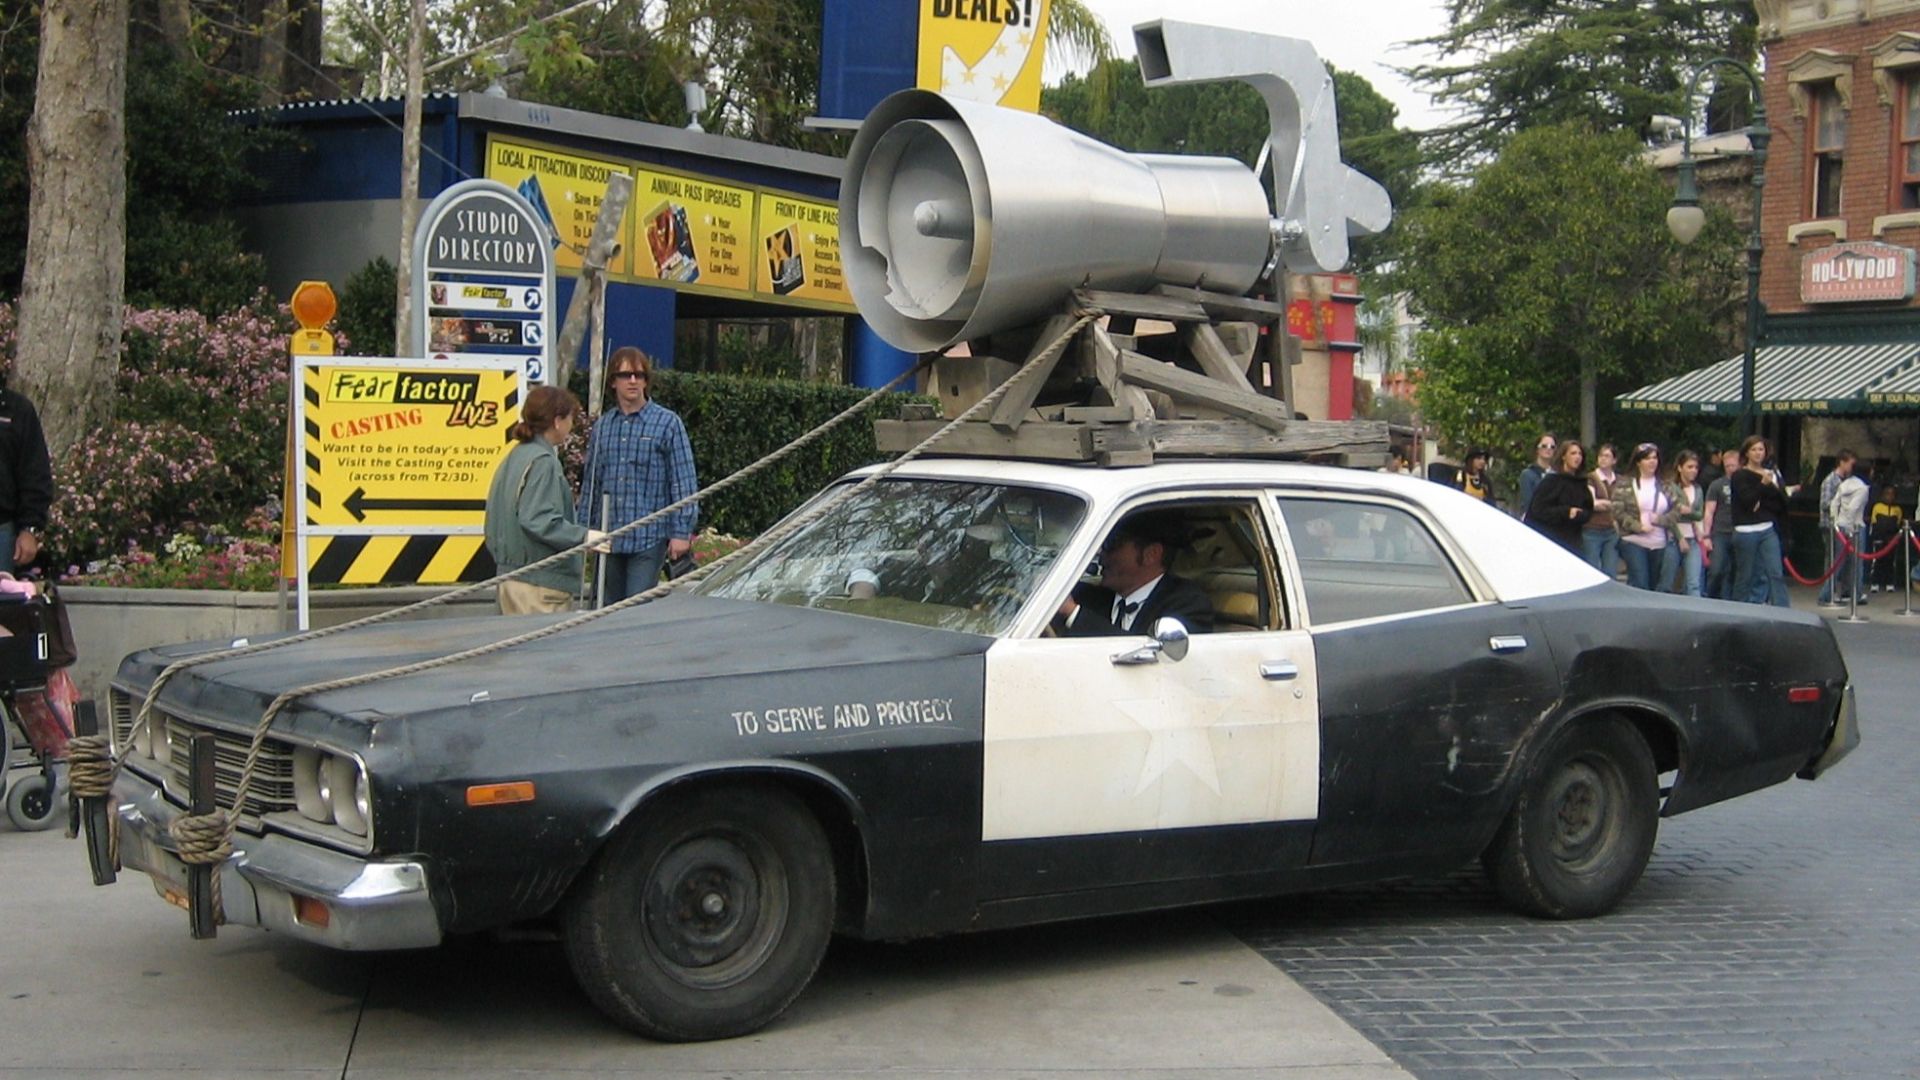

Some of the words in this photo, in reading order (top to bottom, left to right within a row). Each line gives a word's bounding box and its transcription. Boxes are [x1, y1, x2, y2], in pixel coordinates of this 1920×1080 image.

[497, 148, 525, 169] LOCAL
[527, 155, 577, 178] ATTRACTION
[574, 192, 591, 206] Save
[651, 177, 683, 198] ANNUAL
[684, 183, 703, 202] PASS
[704, 187, 742, 209] UPGRADES
[456, 209, 520, 236] STUDIO
[775, 201, 797, 218] FRONT
[797, 205, 806, 220] OF
[807, 207, 821, 223] LINE
[822, 209, 840, 226] PASS
[438, 236, 536, 265] DIRECTORY
[1811, 257, 1896, 283] HOLLYWOOD
[335, 373, 393, 400] Fear
[400, 376, 473, 400] factor
[330, 408, 423, 440] CASTING
[446, 400, 499, 430] LIVE
[323, 443, 356, 454] Want
[360, 443, 373, 454] to
[377, 444, 393, 454] be
[397, 444, 409, 454] in
[413, 445, 459, 456] today's
[463, 445, 502, 456] show?
[338, 457, 366, 467] Visit
[371, 457, 391, 468] the
[395, 458, 443, 470] Casting
[447, 459, 490, 469] Center
[348, 471, 395, 483] (across
[399, 471, 430, 482] from
[434, 472, 479, 484] T2/3D).
[731, 711, 759, 736] TO
[765, 706, 827, 733] SERVE
[833, 703, 871, 729] AND
[876, 698, 953, 726] PROTECT
